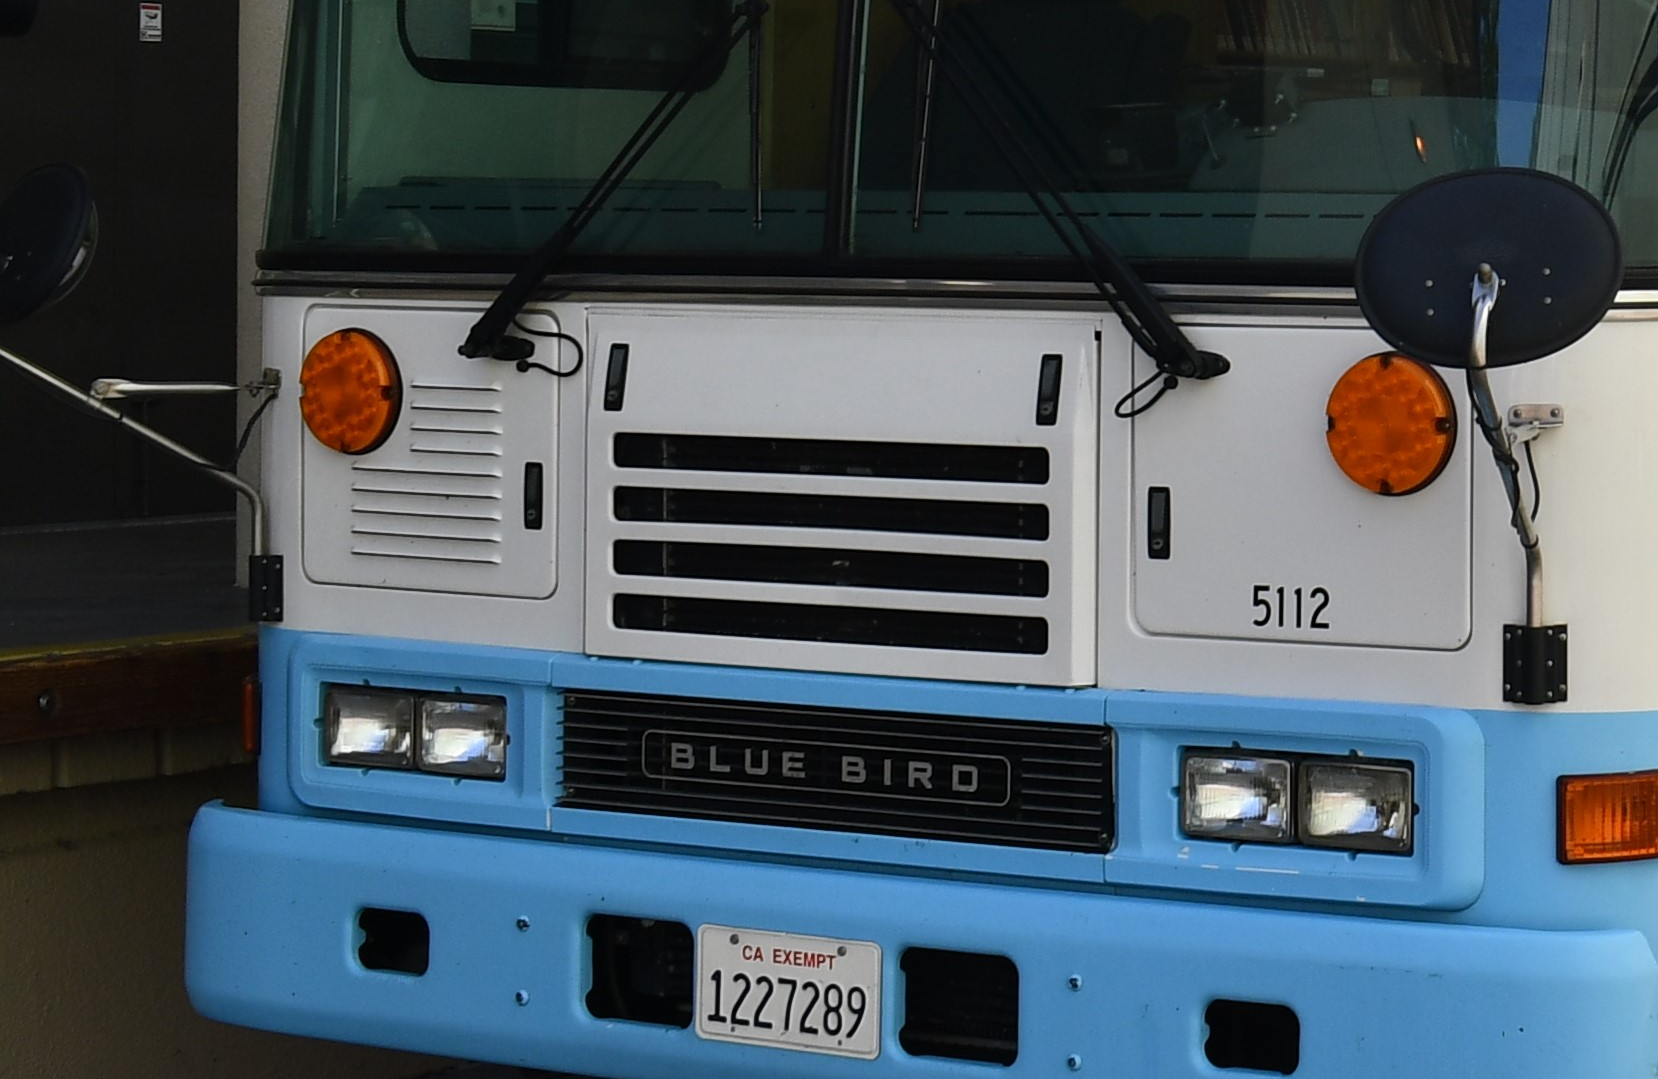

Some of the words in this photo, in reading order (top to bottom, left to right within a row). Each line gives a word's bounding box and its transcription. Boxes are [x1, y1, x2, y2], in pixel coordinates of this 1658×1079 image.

[1253, 585, 1330, 629] 5112
[669, 741, 806, 779] BLUE
[840, 754, 979, 794] BIRD
[741, 944, 764, 963] CA
[772, 948, 838, 971] EXEMPT
[706, 968, 867, 1039] 1227289
